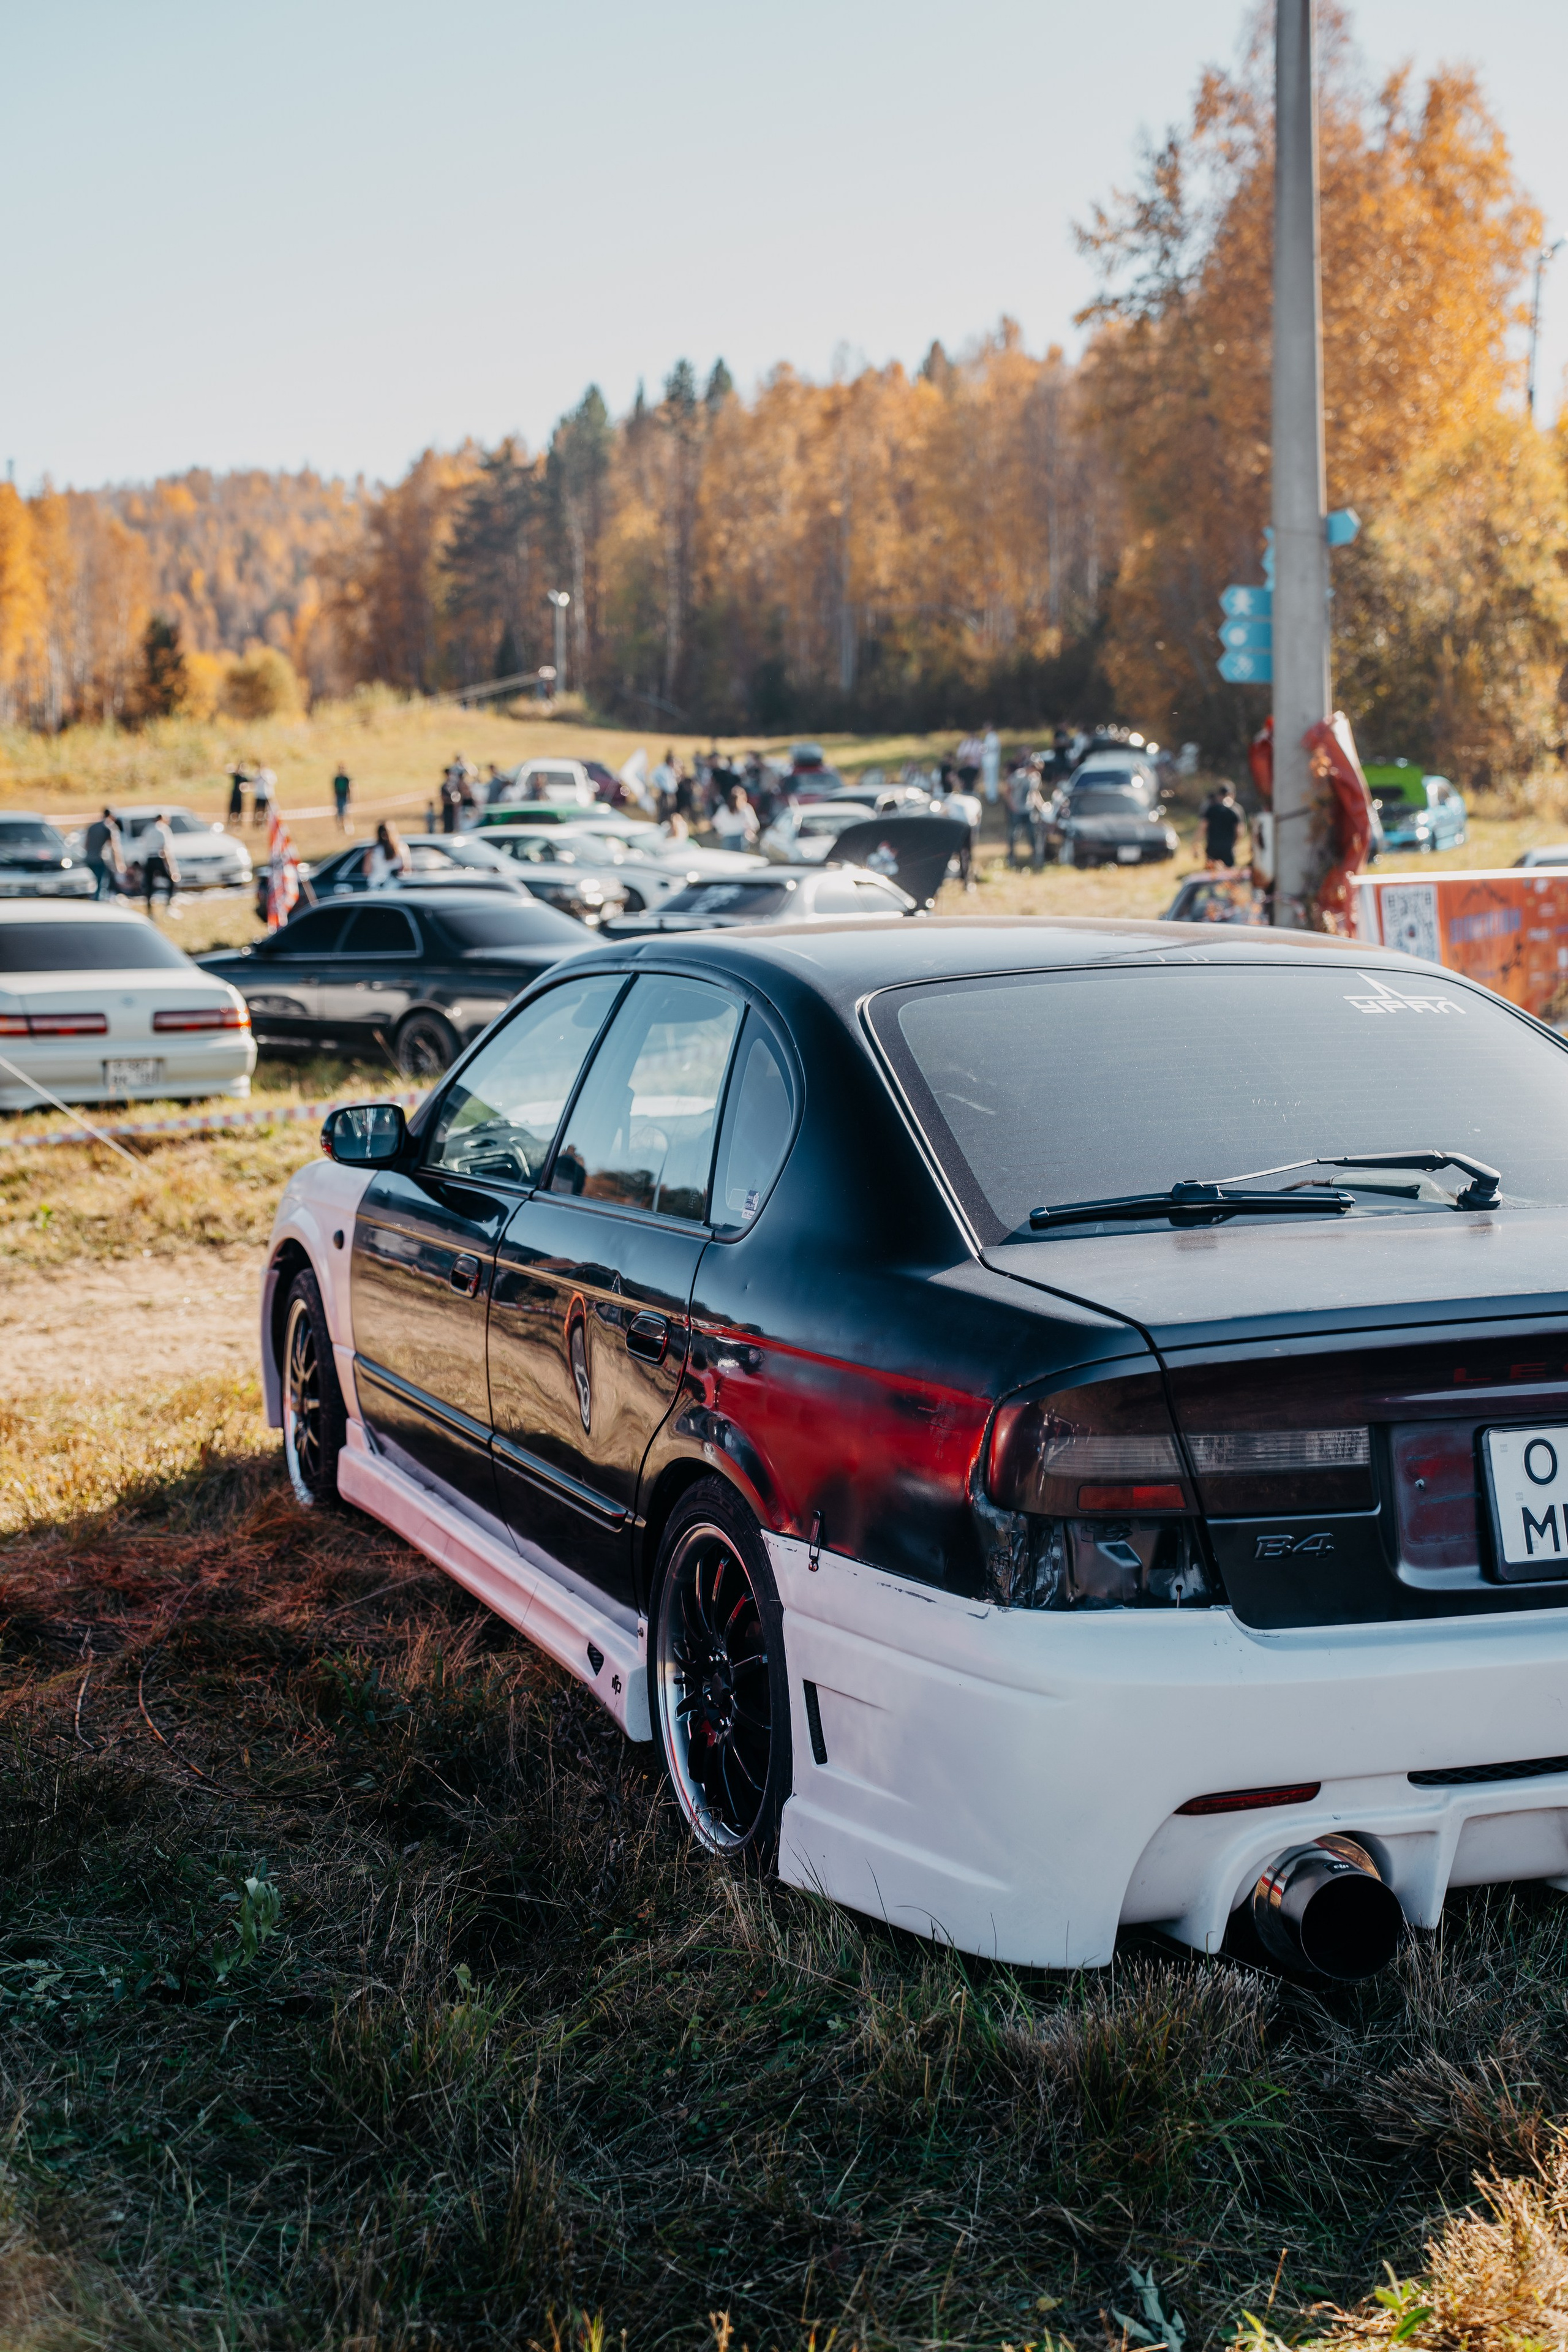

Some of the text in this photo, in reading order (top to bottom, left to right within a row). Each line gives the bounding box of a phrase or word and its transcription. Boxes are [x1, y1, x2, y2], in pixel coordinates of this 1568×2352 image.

[1349, 1000, 1466, 1014] УРАЛ
[1453, 1362, 1568, 1383] LE
[1521, 1504, 1568, 1555] M
[1254, 1532, 1334, 1558] B4
